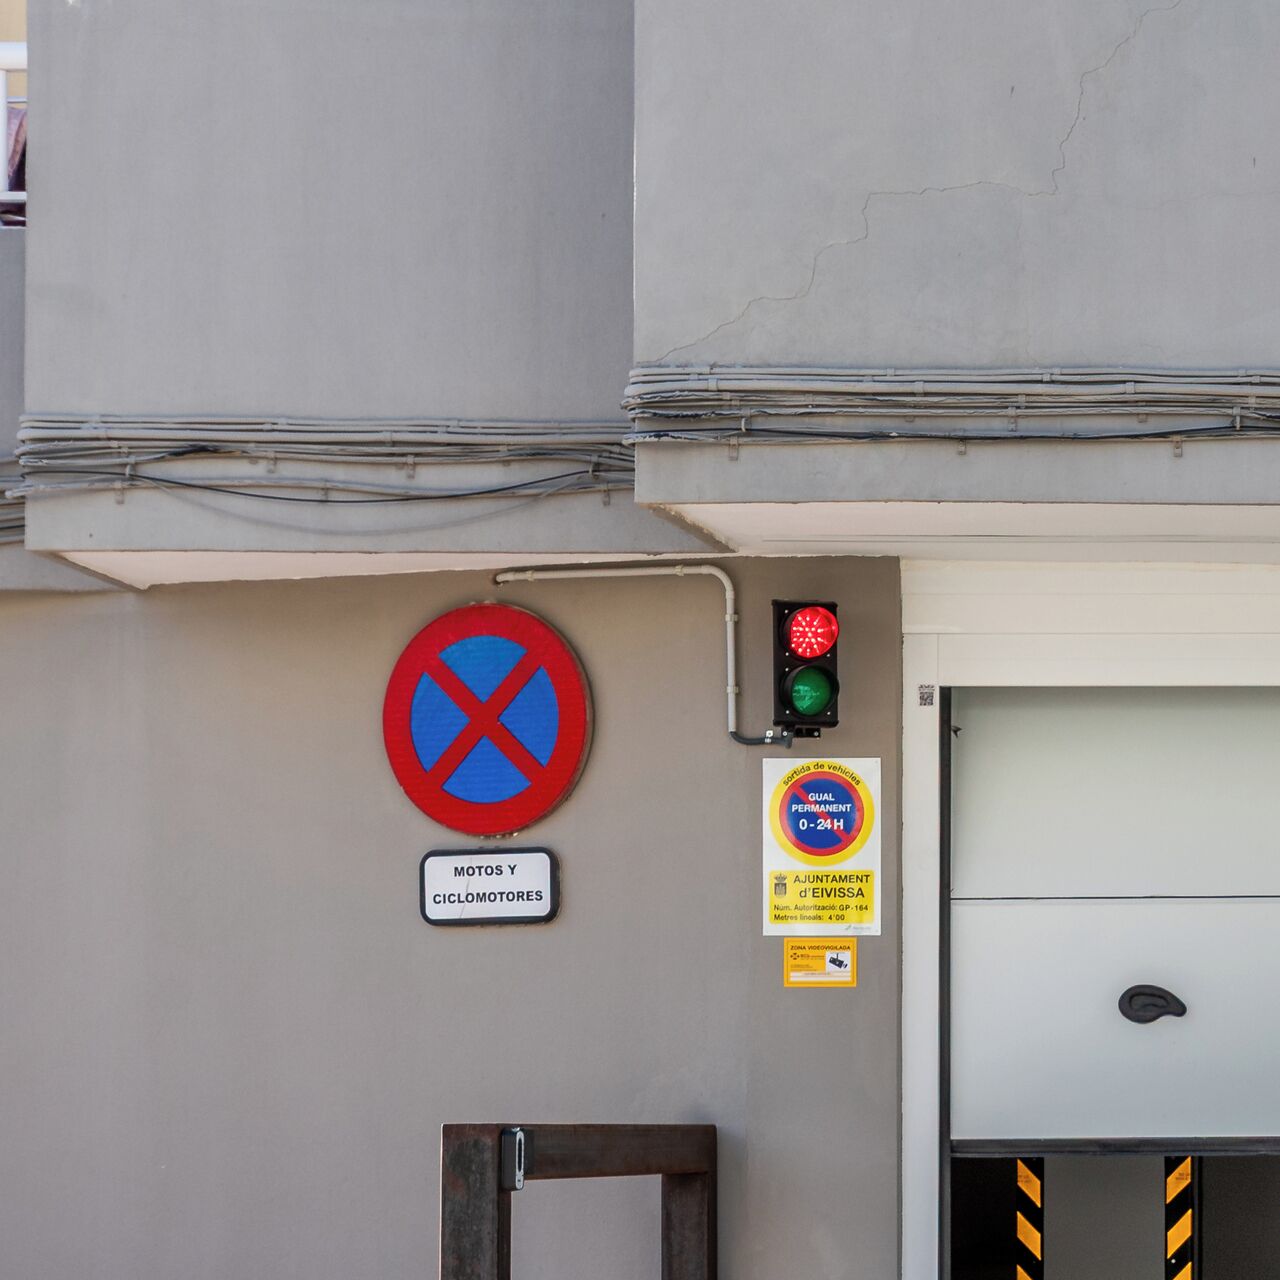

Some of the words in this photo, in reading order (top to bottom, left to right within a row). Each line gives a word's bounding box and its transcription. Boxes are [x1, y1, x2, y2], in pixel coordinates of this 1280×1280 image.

[783, 765, 811, 786] sortida
[813, 762, 825, 770] de
[828, 764, 861, 786] vehicles
[808, 792, 835, 801] GUAL
[791, 804, 852, 813] PERMANENT
[454, 864, 503, 877] MOTOS
[507, 864, 518, 875] Y
[793, 874, 871, 883] AJUNTAMENT
[432, 890, 543, 905] CICLOMOTORES
[799, 887, 865, 898] d'EIVISSA
